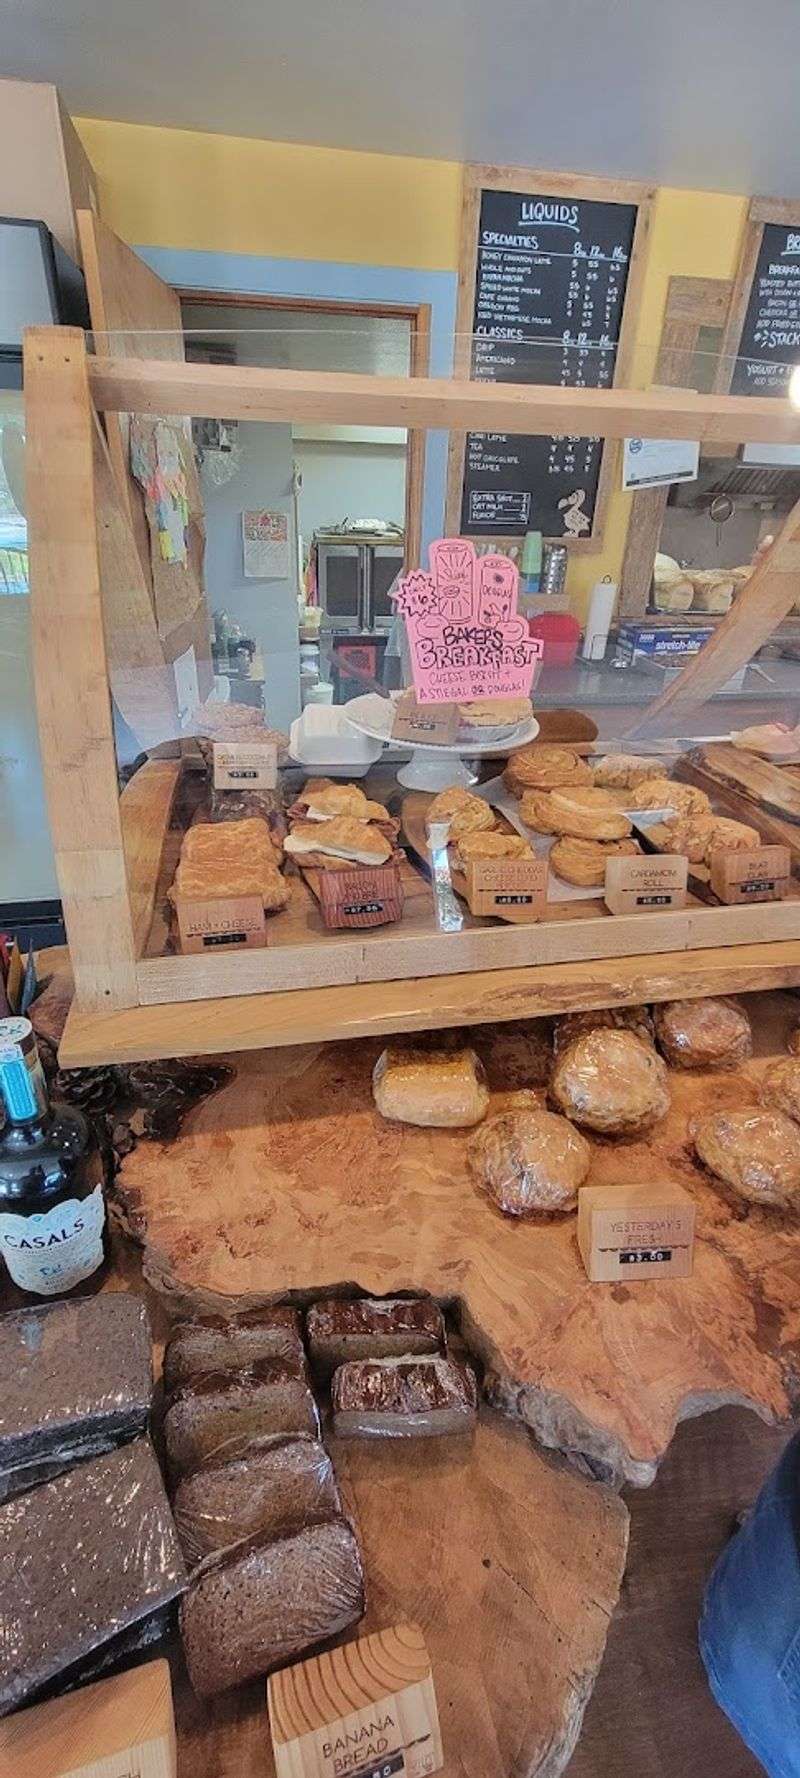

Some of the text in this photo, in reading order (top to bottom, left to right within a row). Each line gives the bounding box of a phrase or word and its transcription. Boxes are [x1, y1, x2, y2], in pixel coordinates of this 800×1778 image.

[521, 202, 579, 224] LIQUIDS
[482, 230, 539, 250] SPECIALTIES
[476, 325, 524, 341] CLASSICS
[415, 638, 540, 670] BREAKFAST
[419, 688, 427, 698] A
[3, 1217, 86, 1250] CASALS
[321, 1714, 395, 1760] BANANA
[332, 1737, 389, 1774] BREAD
